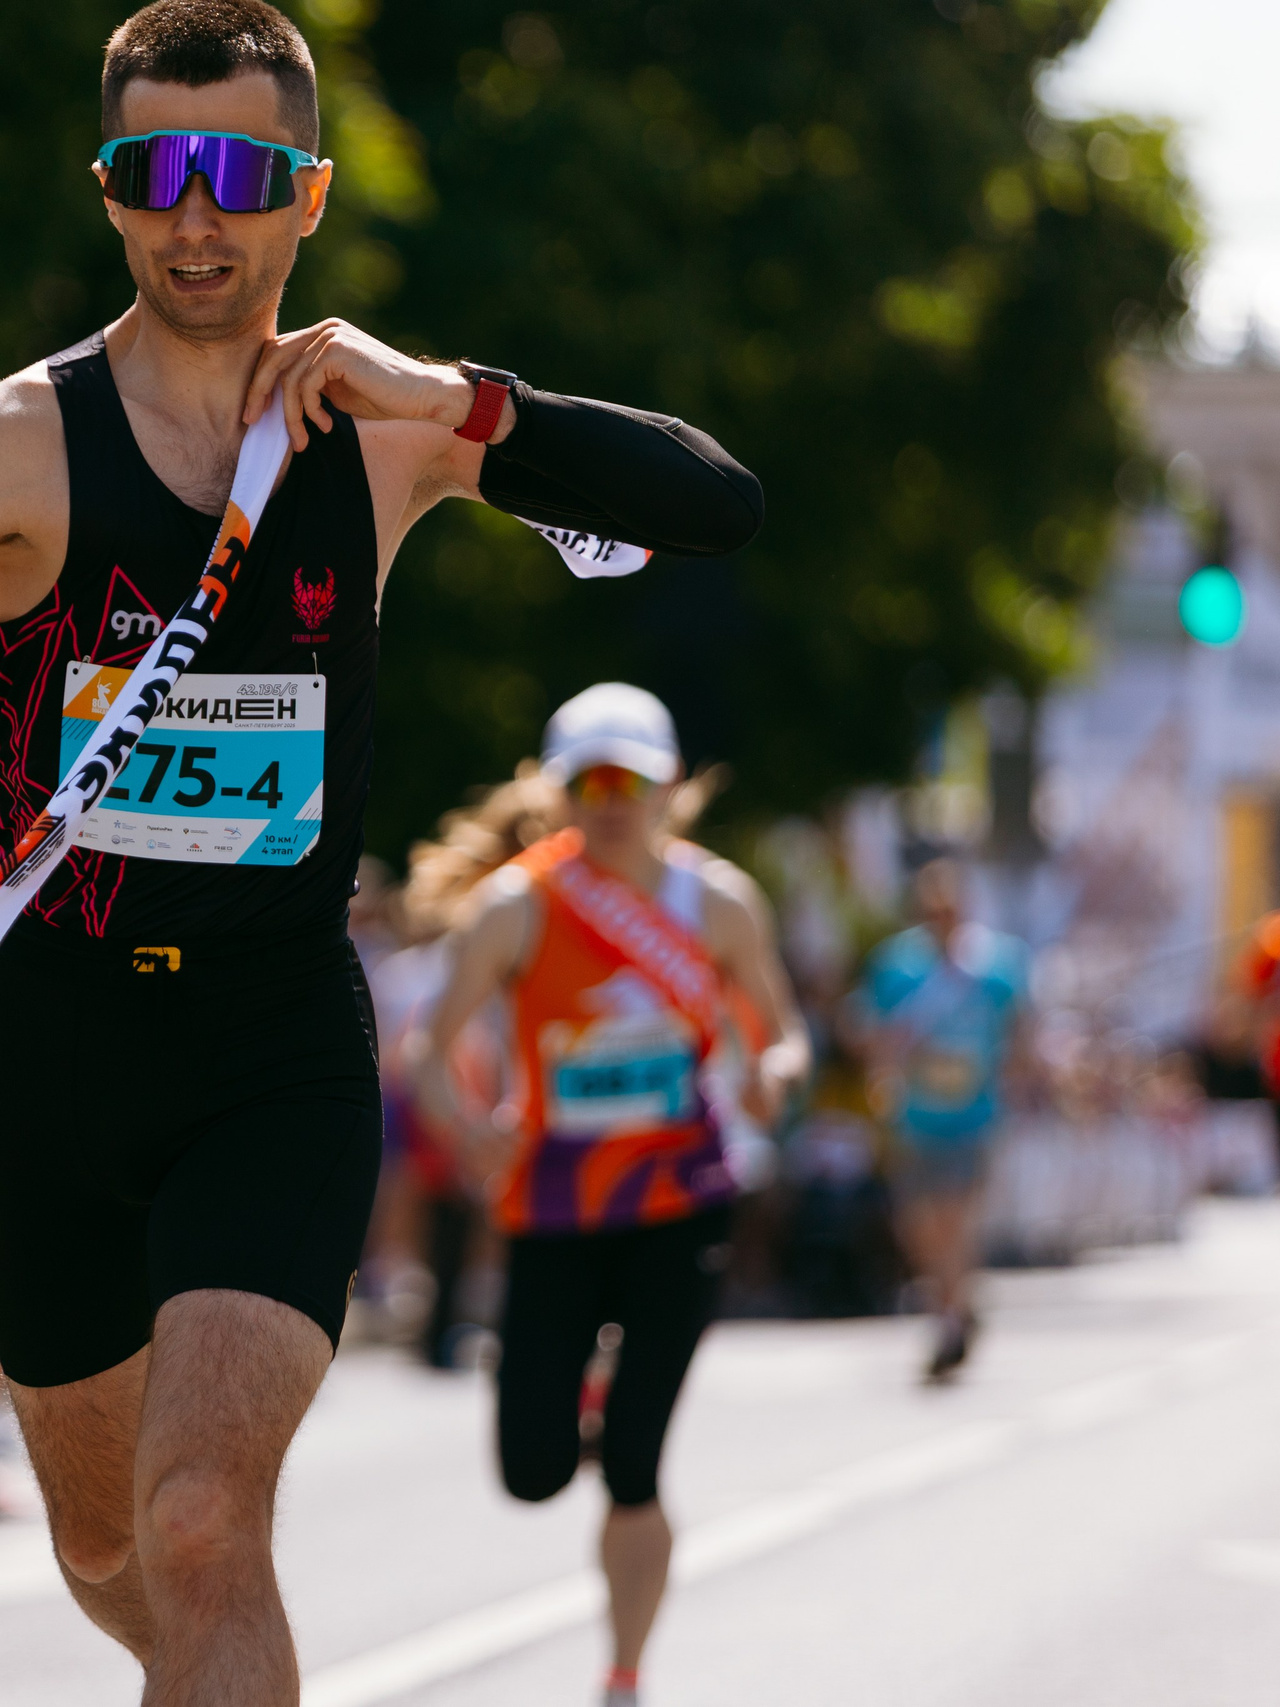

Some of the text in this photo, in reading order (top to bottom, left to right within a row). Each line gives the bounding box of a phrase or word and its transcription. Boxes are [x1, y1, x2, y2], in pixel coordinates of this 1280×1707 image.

[236, 681, 299, 697] 42.195/6
[154, 697, 297, 724] КИДЕН
[265, 834, 276, 843] 10
[261, 846, 269, 855] 4
